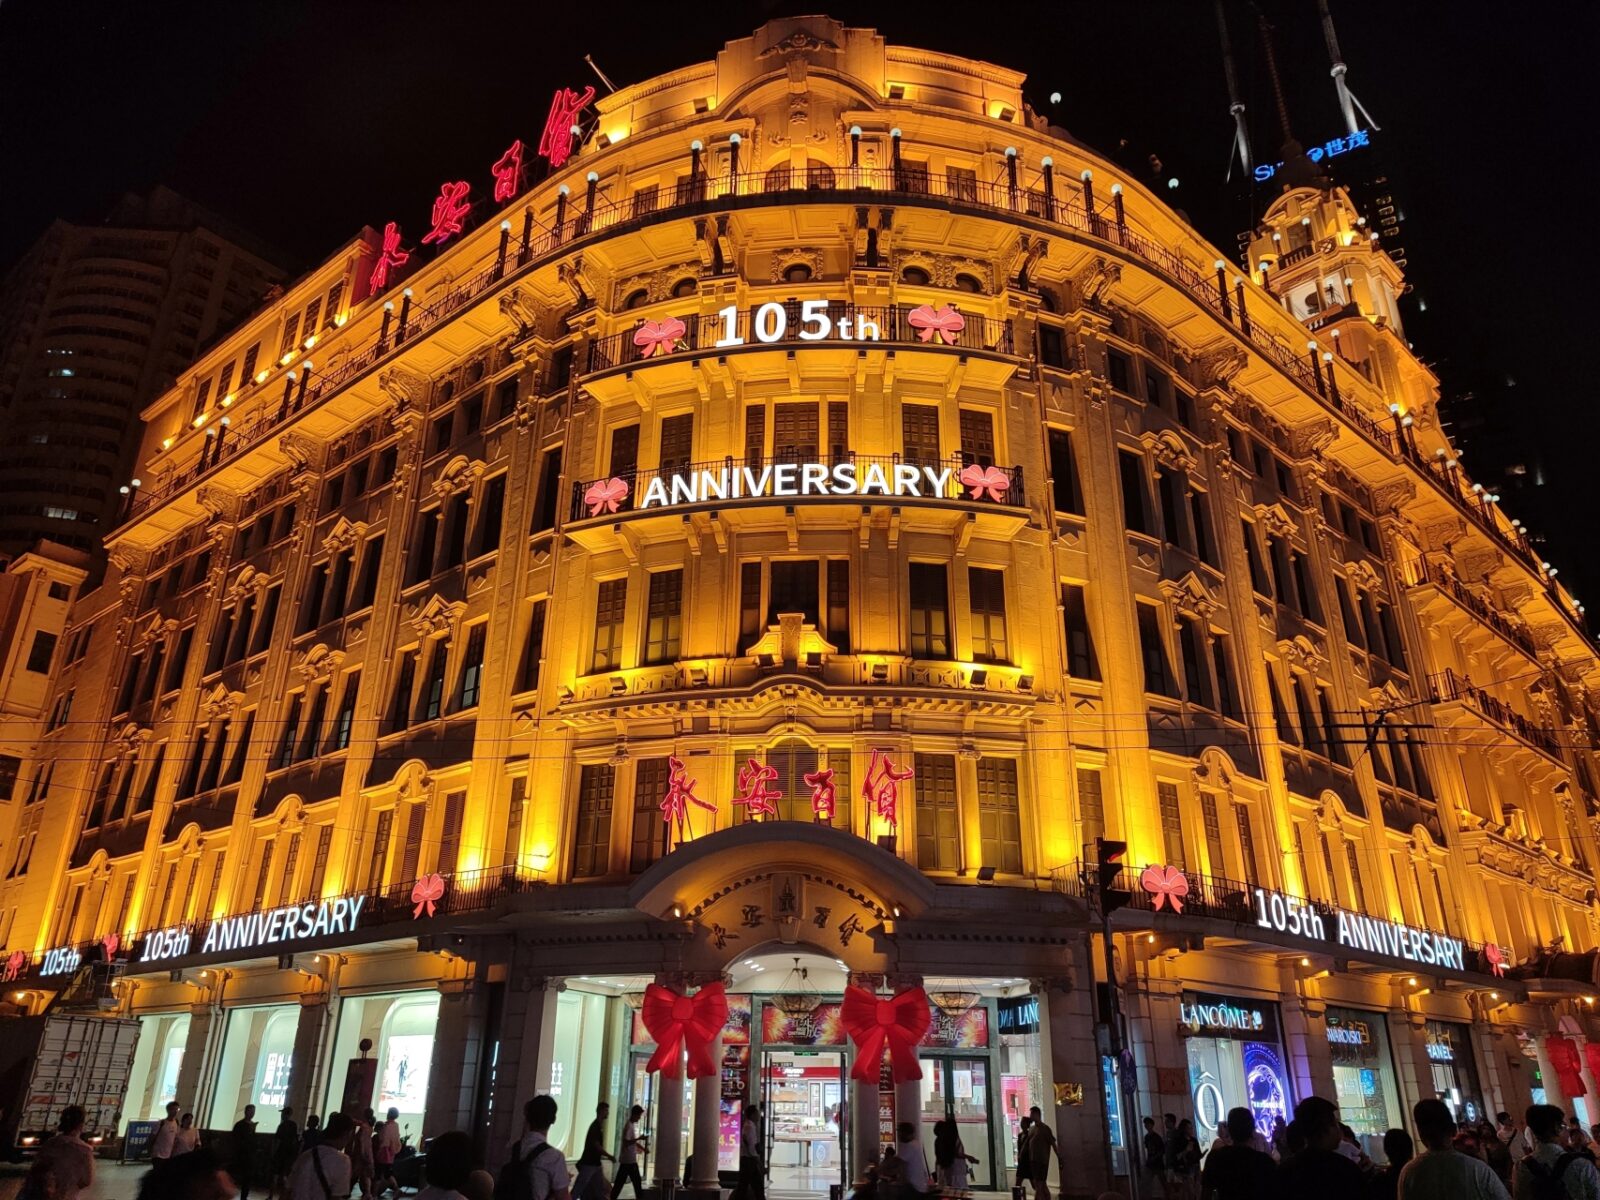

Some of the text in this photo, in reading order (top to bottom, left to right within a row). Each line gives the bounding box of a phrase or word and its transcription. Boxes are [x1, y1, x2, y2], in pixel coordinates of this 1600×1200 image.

[1324, 129, 1370, 158] 世茂
[715, 299, 881, 348] 105th
[641, 463, 952, 509] ANNIVERSARY
[140, 895, 366, 963] 105th ANNIVERSARY
[1254, 888, 1465, 971] 105th ANNIVERSARY
[39, 946, 82, 977] 105th
[1180, 1003, 1251, 1030] LANCÔME
